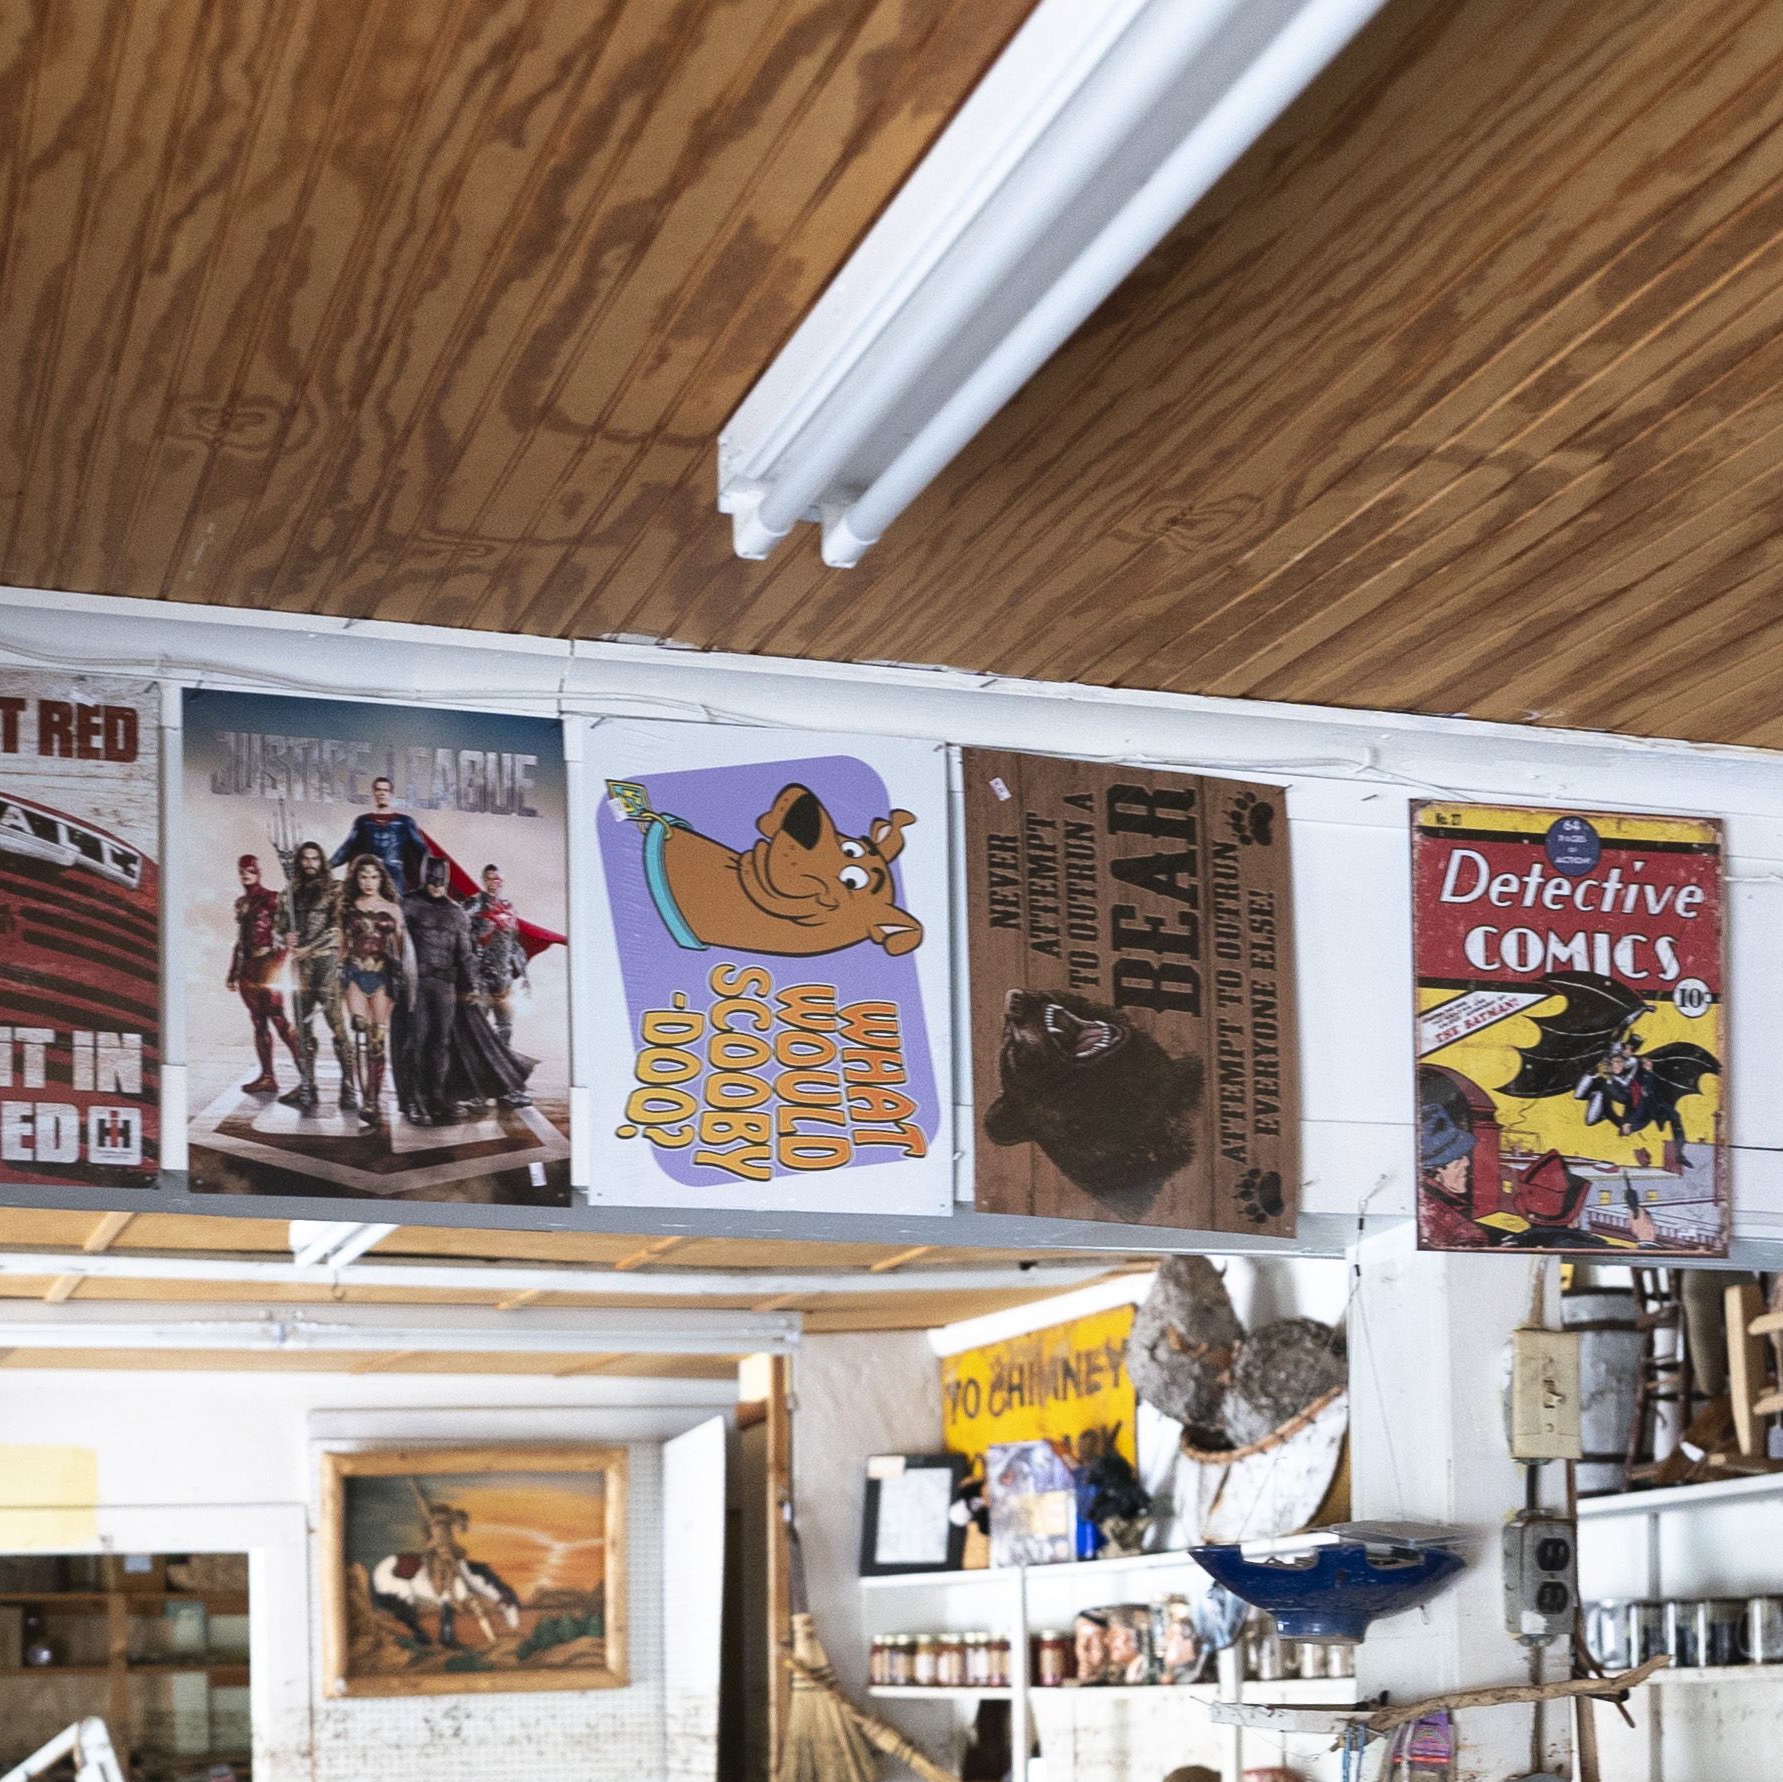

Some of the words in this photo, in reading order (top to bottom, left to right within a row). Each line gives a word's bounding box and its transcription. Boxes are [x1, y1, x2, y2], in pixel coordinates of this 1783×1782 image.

[37, 699, 139, 763] RED
[211, 731, 371, 805] JUSTICE
[384, 745, 542, 817] LEAGUE
[1064, 792, 1095, 813] A
[987, 832, 1021, 931] NEVER
[1026, 811, 1062, 960] ATTEMPT
[1065, 820, 1098, 943] OUTRUN
[1107, 783, 1202, 1018] BEAR
[1213, 840, 1241, 961] OUTRUN
[1439, 849, 1705, 919] Detective
[1069, 950, 1100, 990] TO
[1248, 889, 1279, 972] ELSE!
[1464, 925, 1682, 980] COMICS
[1217, 962, 1244, 1011] TO
[72, 1030, 143, 1093] IN
[692, 962, 774, 1182] SCOOBY
[774, 983, 853, 1172] WOULD
[838, 1000, 928, 1159] WHAT
[1220, 1018, 1248, 1165] ATTEMPT
[1251, 979, 1282, 1138] EVERYONE
[946, 1377, 980, 1425] TO
